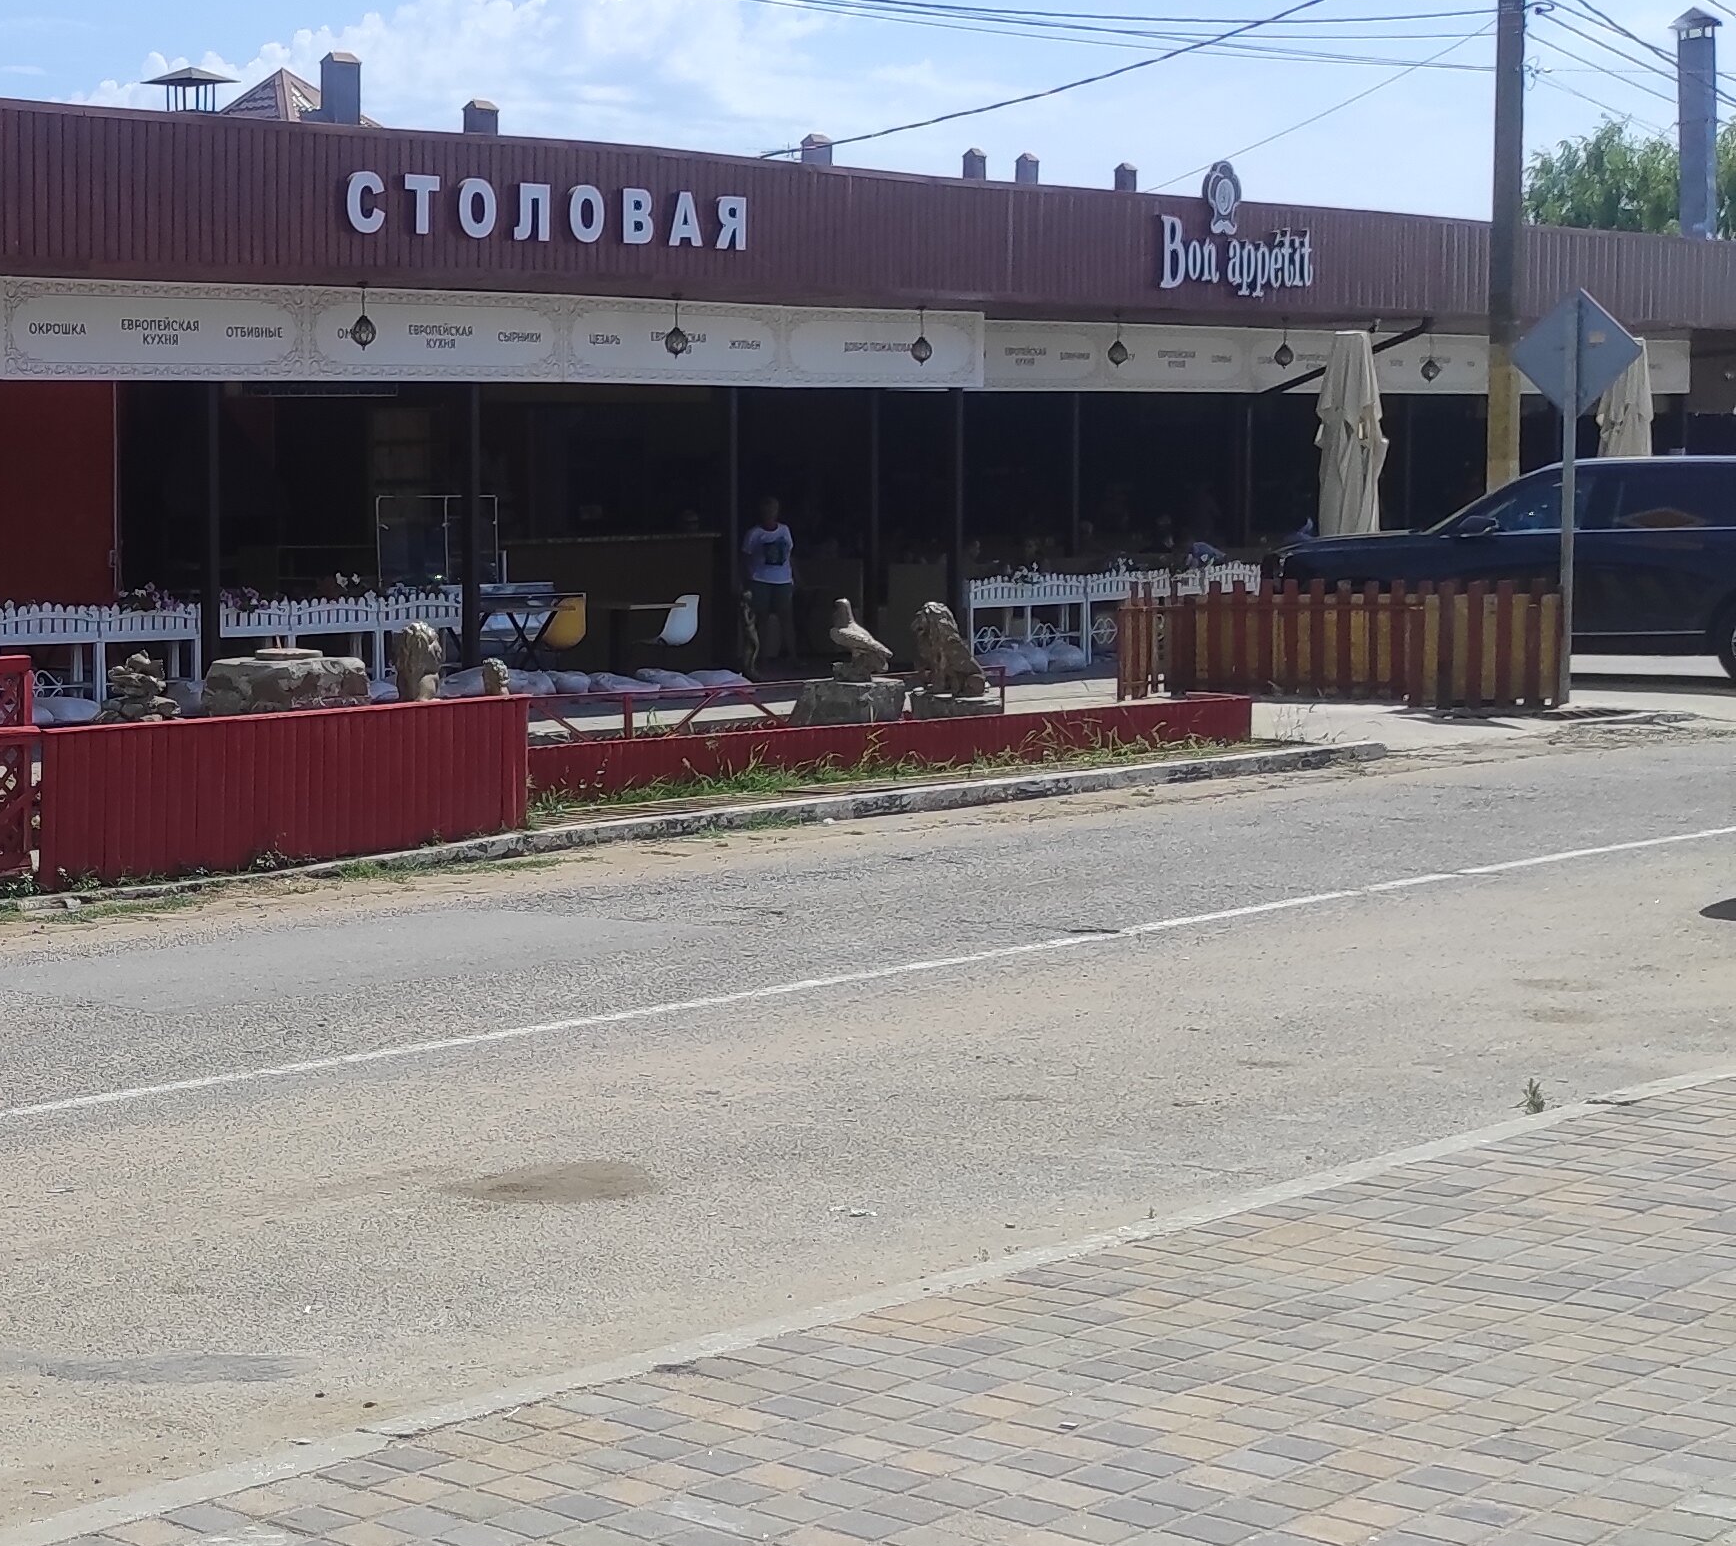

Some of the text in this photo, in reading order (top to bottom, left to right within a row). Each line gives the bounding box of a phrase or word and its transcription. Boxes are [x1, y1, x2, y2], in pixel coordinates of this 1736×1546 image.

[347, 171, 748, 250] СТОЛОВАЯ
[1160, 214, 1220, 289] Bon
[29, 322, 86, 335] ОКРОШКА
[121, 317, 200, 332] ЕВРОПЕЙСКАЯ
[408, 322, 473, 336] ЕВРОПЕЙСКАЯ
[226, 326, 283, 339] ОТБИВНЫЕ
[497, 331, 542, 343] СЫРНИКИ
[142, 333, 179, 346] КУХНЯ
[426, 338, 456, 350] КУХНЯ
[589, 333, 621, 346] ЦЕЗАРЬ
